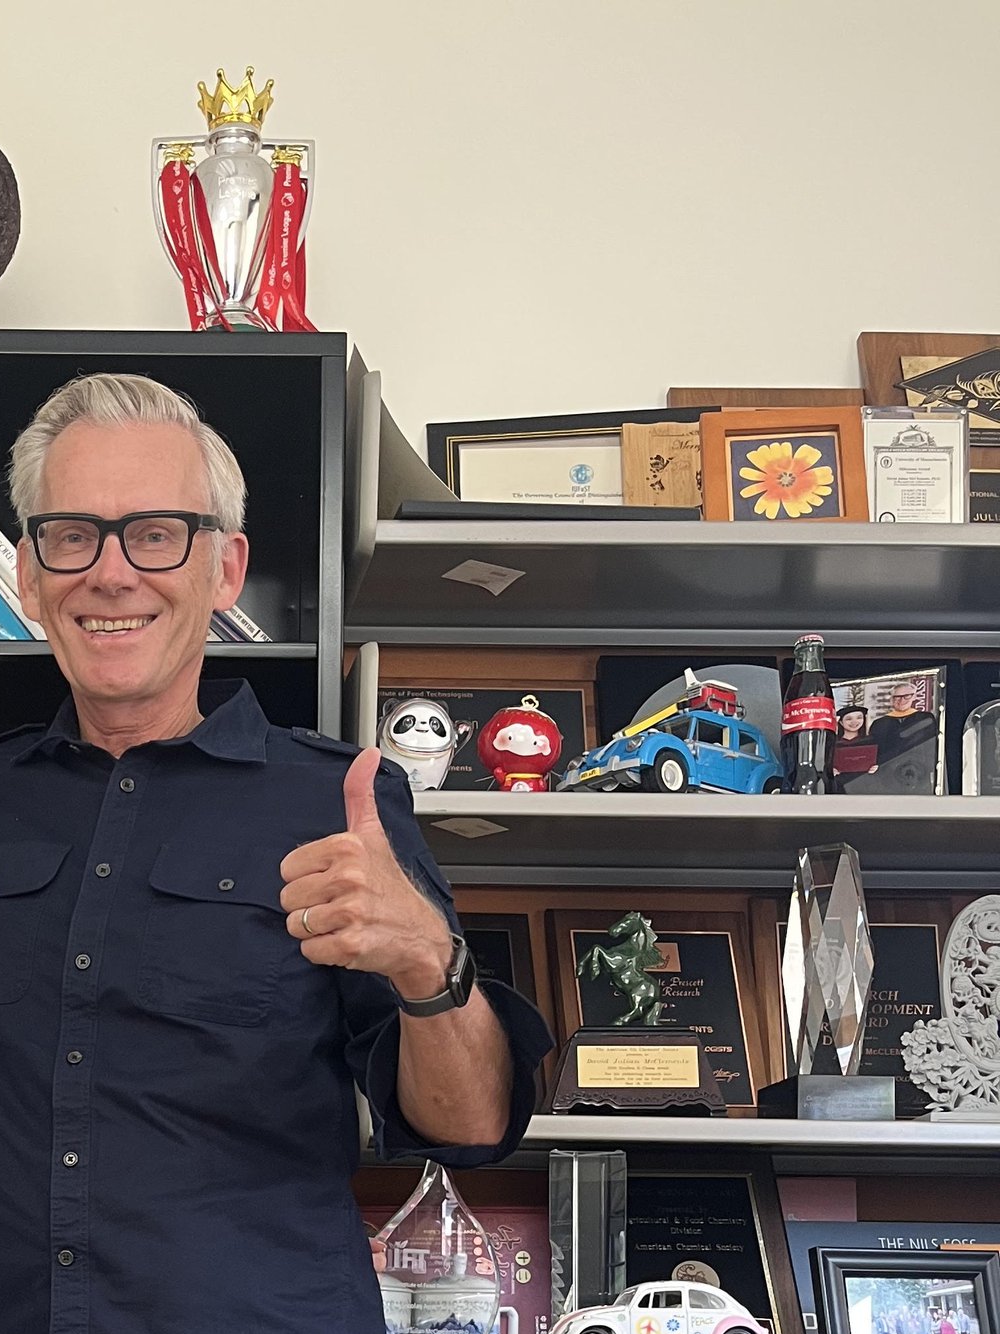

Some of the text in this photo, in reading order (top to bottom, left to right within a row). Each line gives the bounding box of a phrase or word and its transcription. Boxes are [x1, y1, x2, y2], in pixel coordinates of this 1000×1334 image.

[281, 211, 291, 237] League
[915, 679, 926, 712] UMASS
[670, 977, 704, 988] Prescott
[662, 986, 700, 997] Research
[878, 1237, 941, 1250] THE NILS
